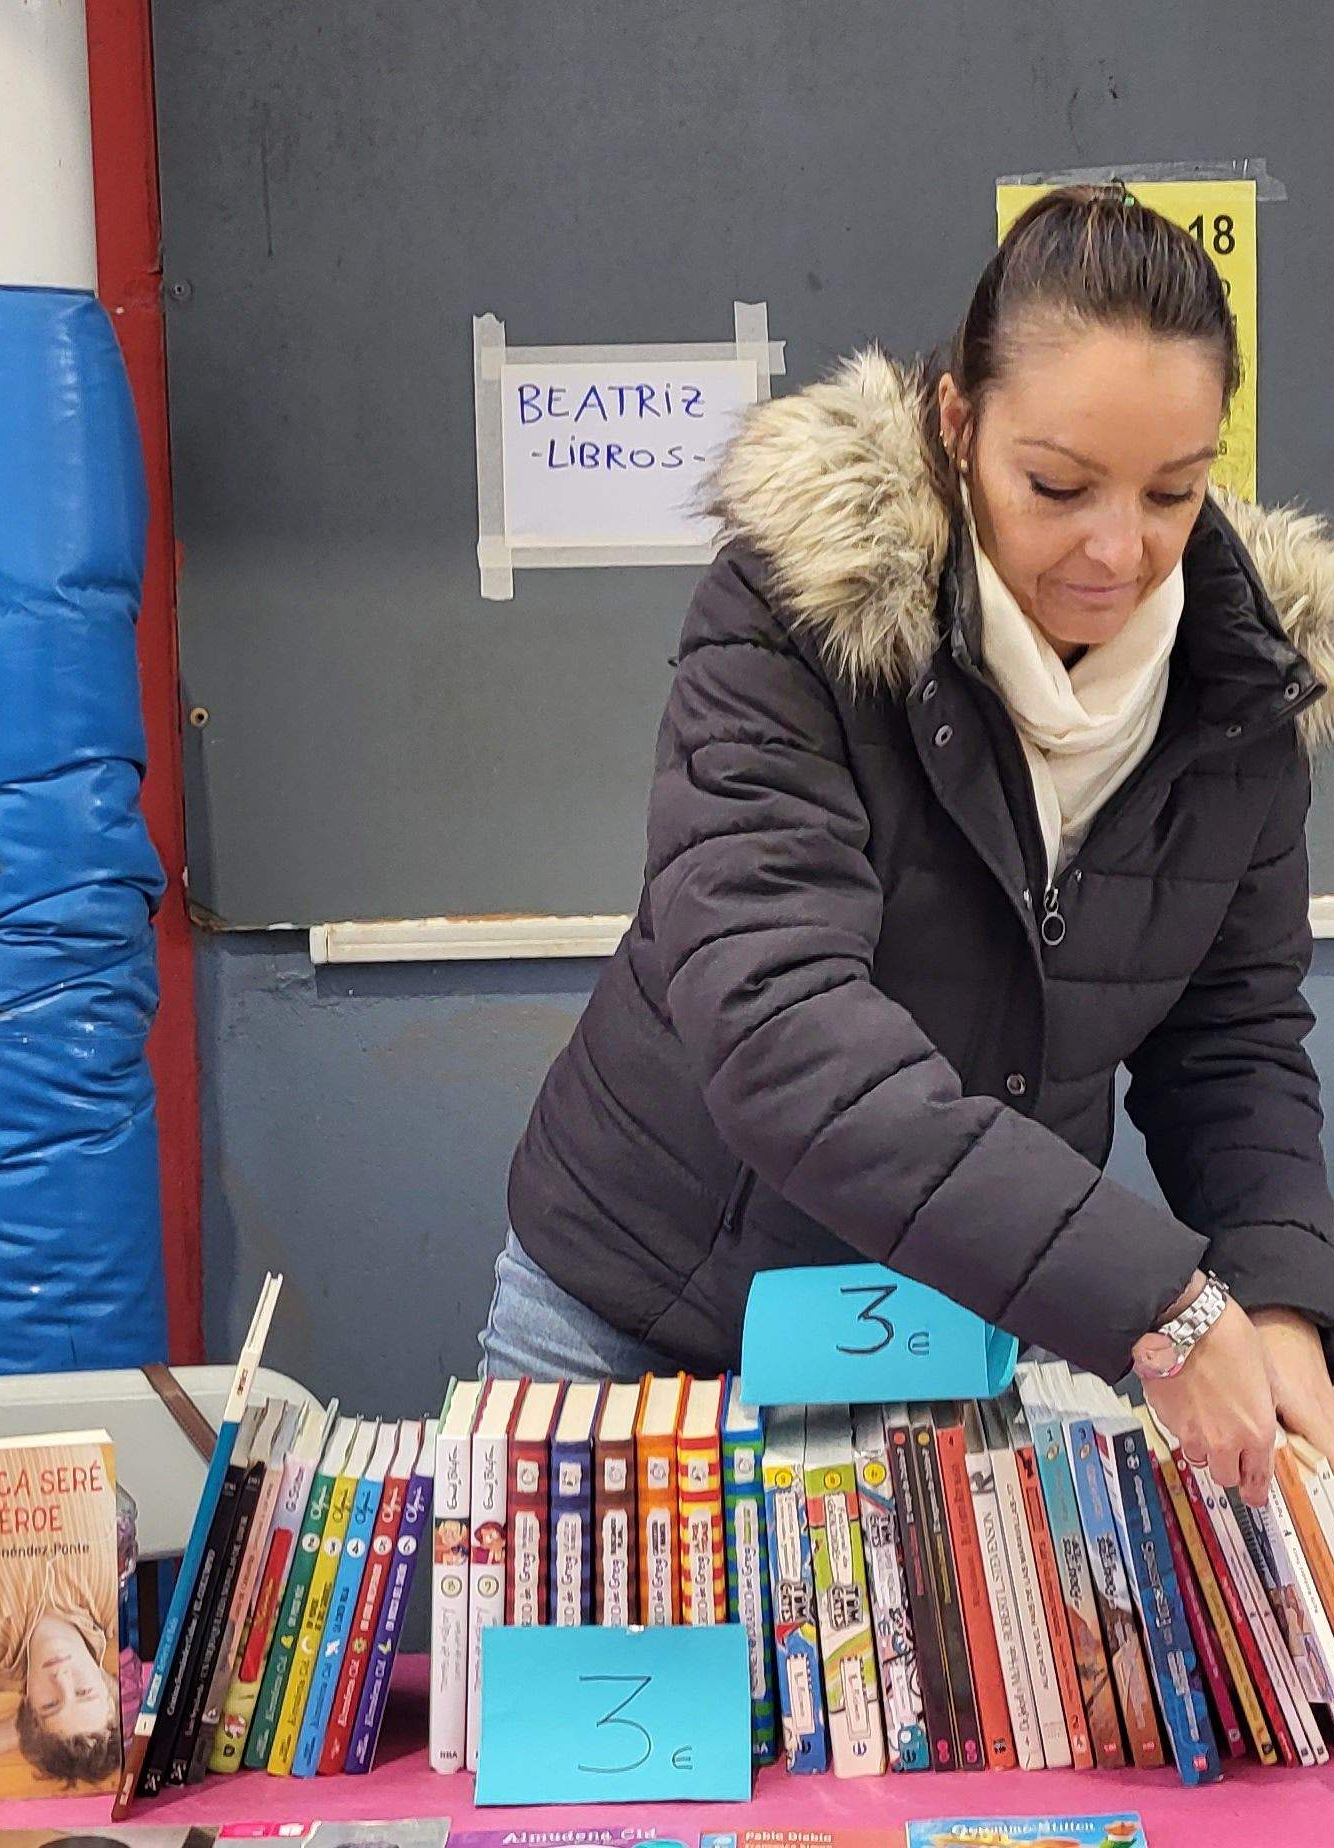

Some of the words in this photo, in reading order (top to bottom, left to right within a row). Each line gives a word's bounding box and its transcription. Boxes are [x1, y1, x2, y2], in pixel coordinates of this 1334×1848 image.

[40, 1460, 104, 1496] SERÉ
[518, 1552, 535, 1583] Greg
[561, 1555, 577, 1585] Greg
[608, 1558, 624, 1589] Greg
[651, 1557, 667, 1588] Greg
[694, 1555, 709, 1585] Greg
